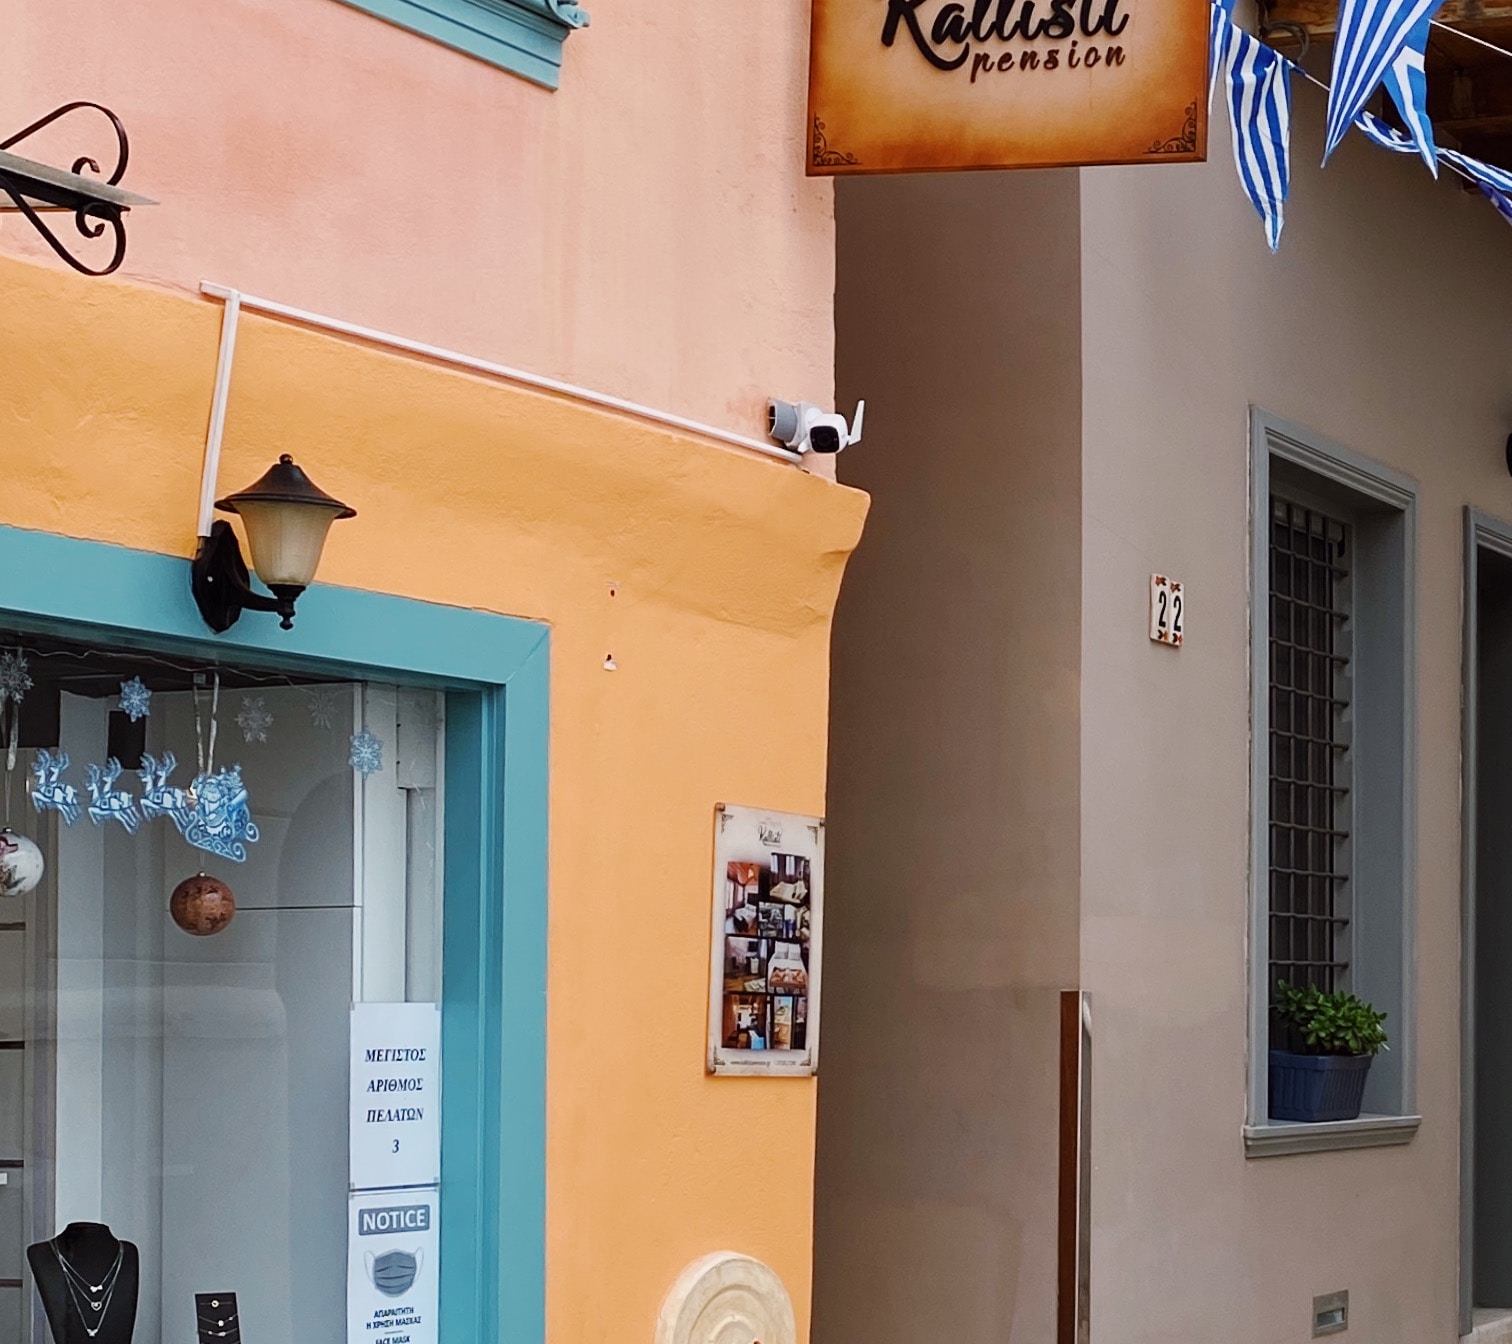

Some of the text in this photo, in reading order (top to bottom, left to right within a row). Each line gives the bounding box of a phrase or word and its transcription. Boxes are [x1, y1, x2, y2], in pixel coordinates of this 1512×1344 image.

[970, 40, 1126, 84] pension
[1158, 590, 1182, 633] 22
[364, 1047, 427, 1063] ΜΕΓΙΣΤΟΣ
[366, 1077, 424, 1093] ΑΡΙΘΜΟΣ
[366, 1107, 425, 1123] ΠΕΛΑΤΩΝ
[391, 1138, 400, 1154] 3
[362, 1208, 426, 1232] NOTICE
[392, 1335, 411, 1344] MASK
